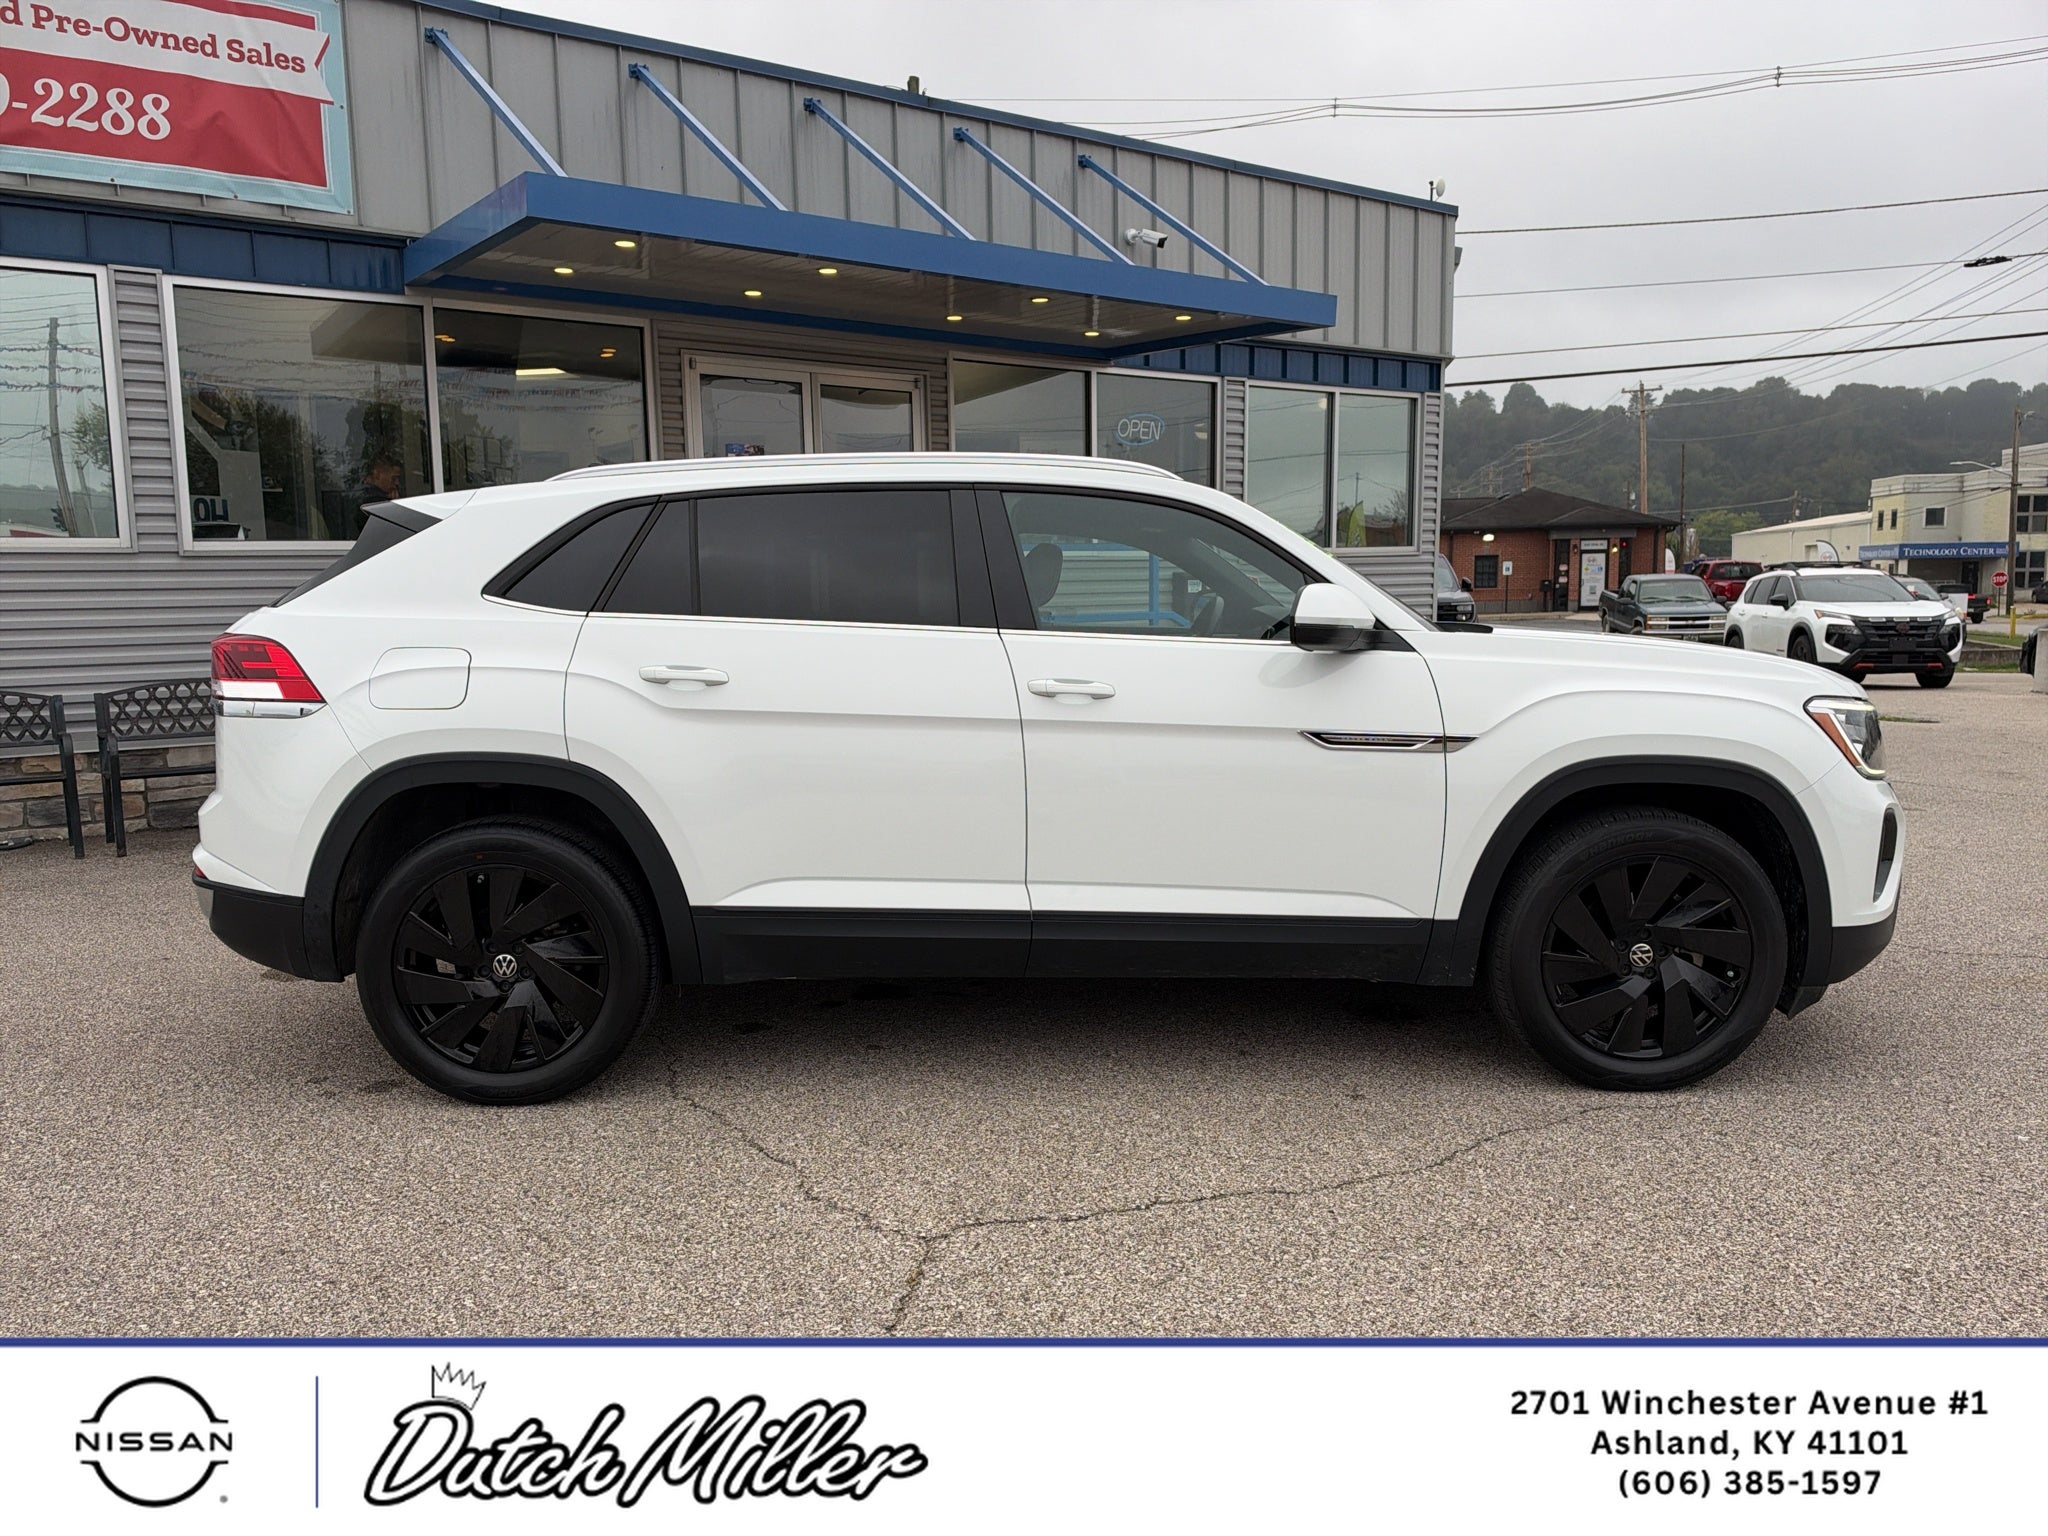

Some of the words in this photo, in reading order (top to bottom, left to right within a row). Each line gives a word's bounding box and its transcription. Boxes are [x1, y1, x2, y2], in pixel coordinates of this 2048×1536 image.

[30, 4, 219, 59] Pre-Owned
[226, 38, 306, 74] Sales
[1117, 418, 1161, 440] OPEN
[1903, 547, 1958, 557] TECHNOLOGY
[1960, 546, 1994, 556] CENTER
[1992, 575, 2008, 584] STOP
